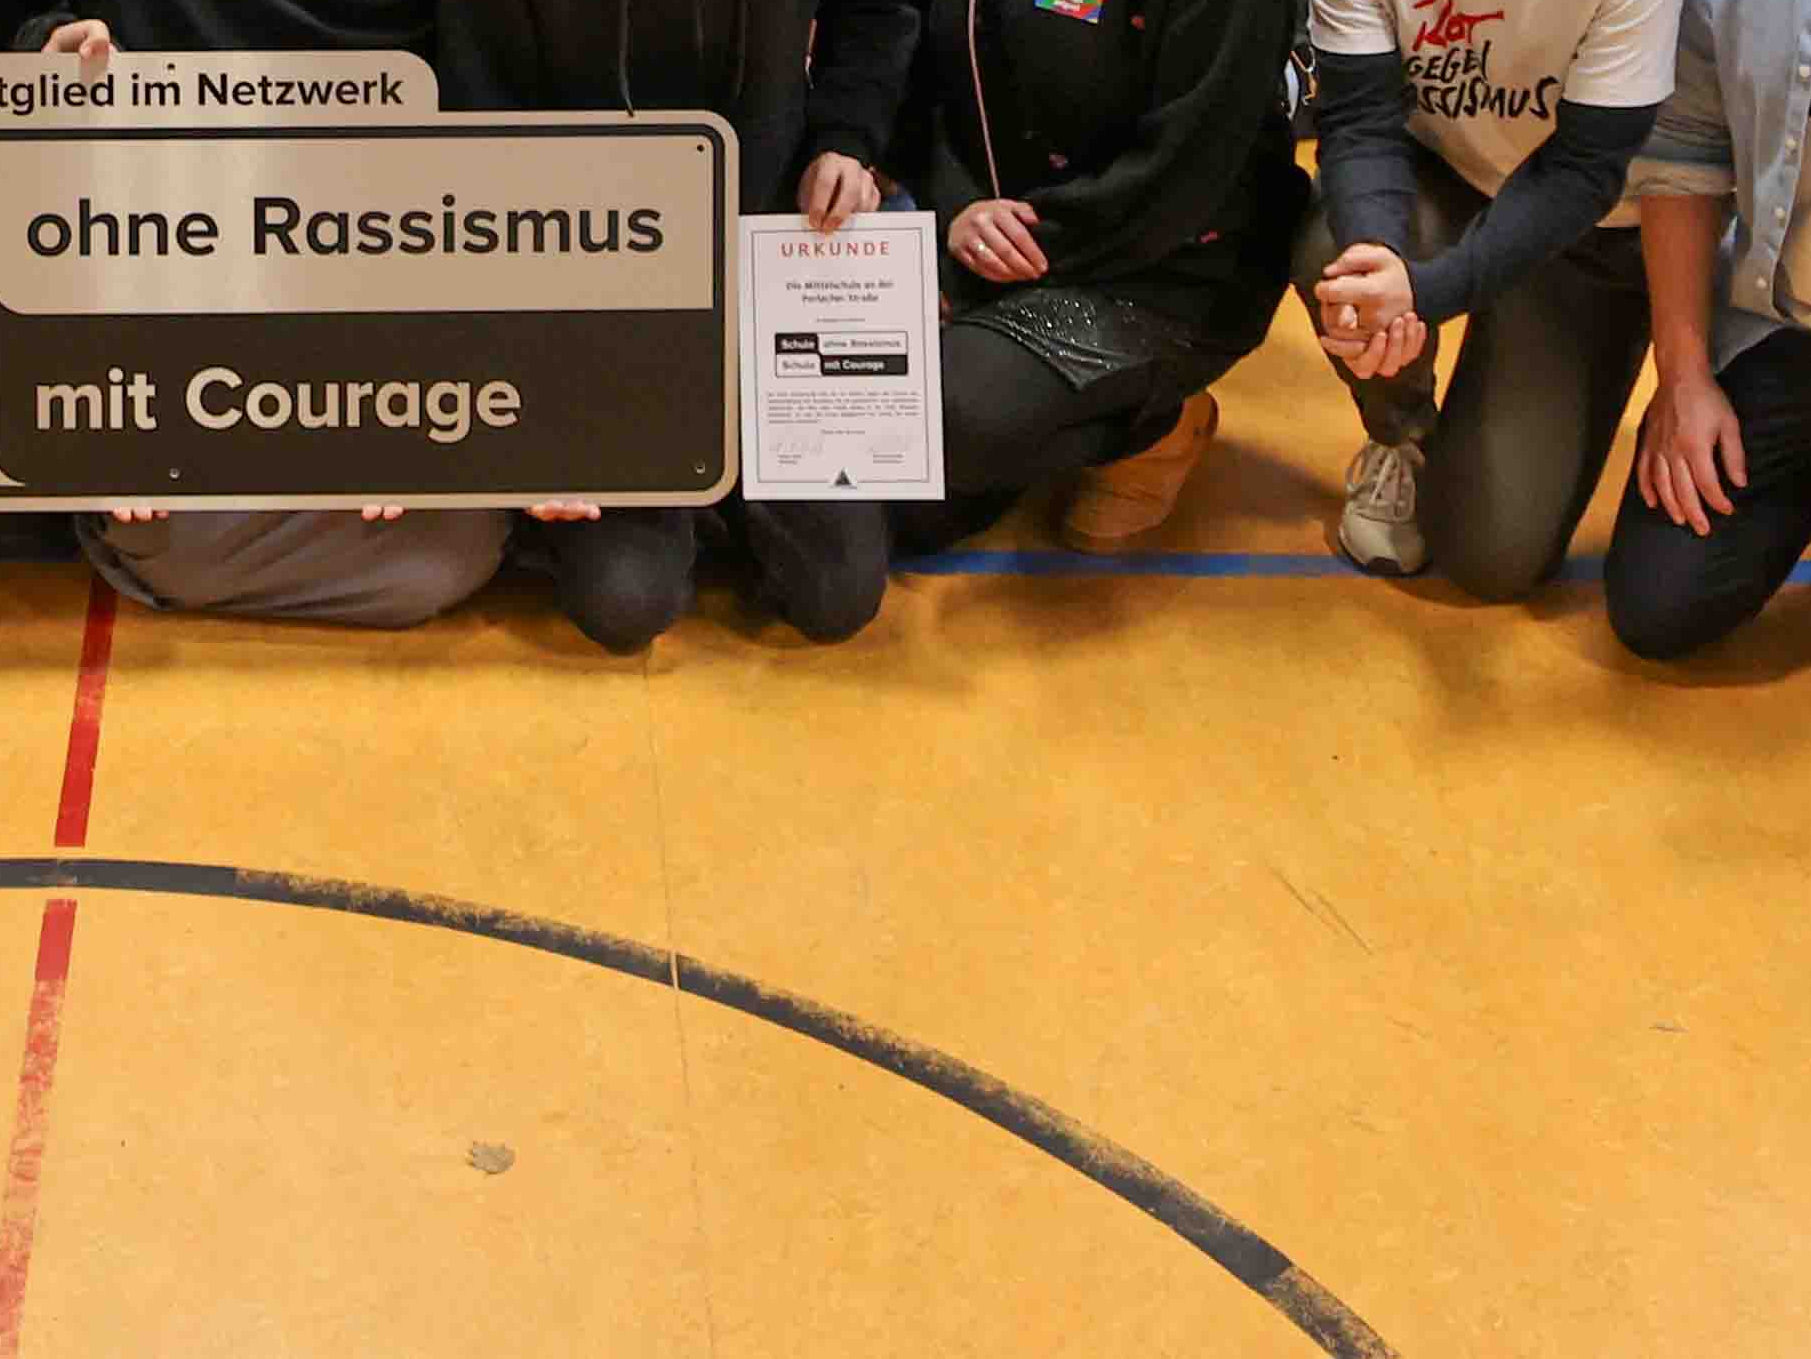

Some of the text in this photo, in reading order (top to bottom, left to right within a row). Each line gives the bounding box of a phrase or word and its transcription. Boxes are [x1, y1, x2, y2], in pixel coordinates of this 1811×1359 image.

[132, 71, 181, 108] im
[197, 71, 404, 107] Netzwerk
[26, 197, 219, 257] ohne
[252, 193, 665, 256] Rassismus
[781, 241, 891, 257] URKUNDE
[781, 338, 816, 350] Schule
[781, 359, 816, 370] Schule
[842, 359, 885, 371] Courage
[35, 367, 159, 431] mit
[185, 365, 522, 444] Courage
